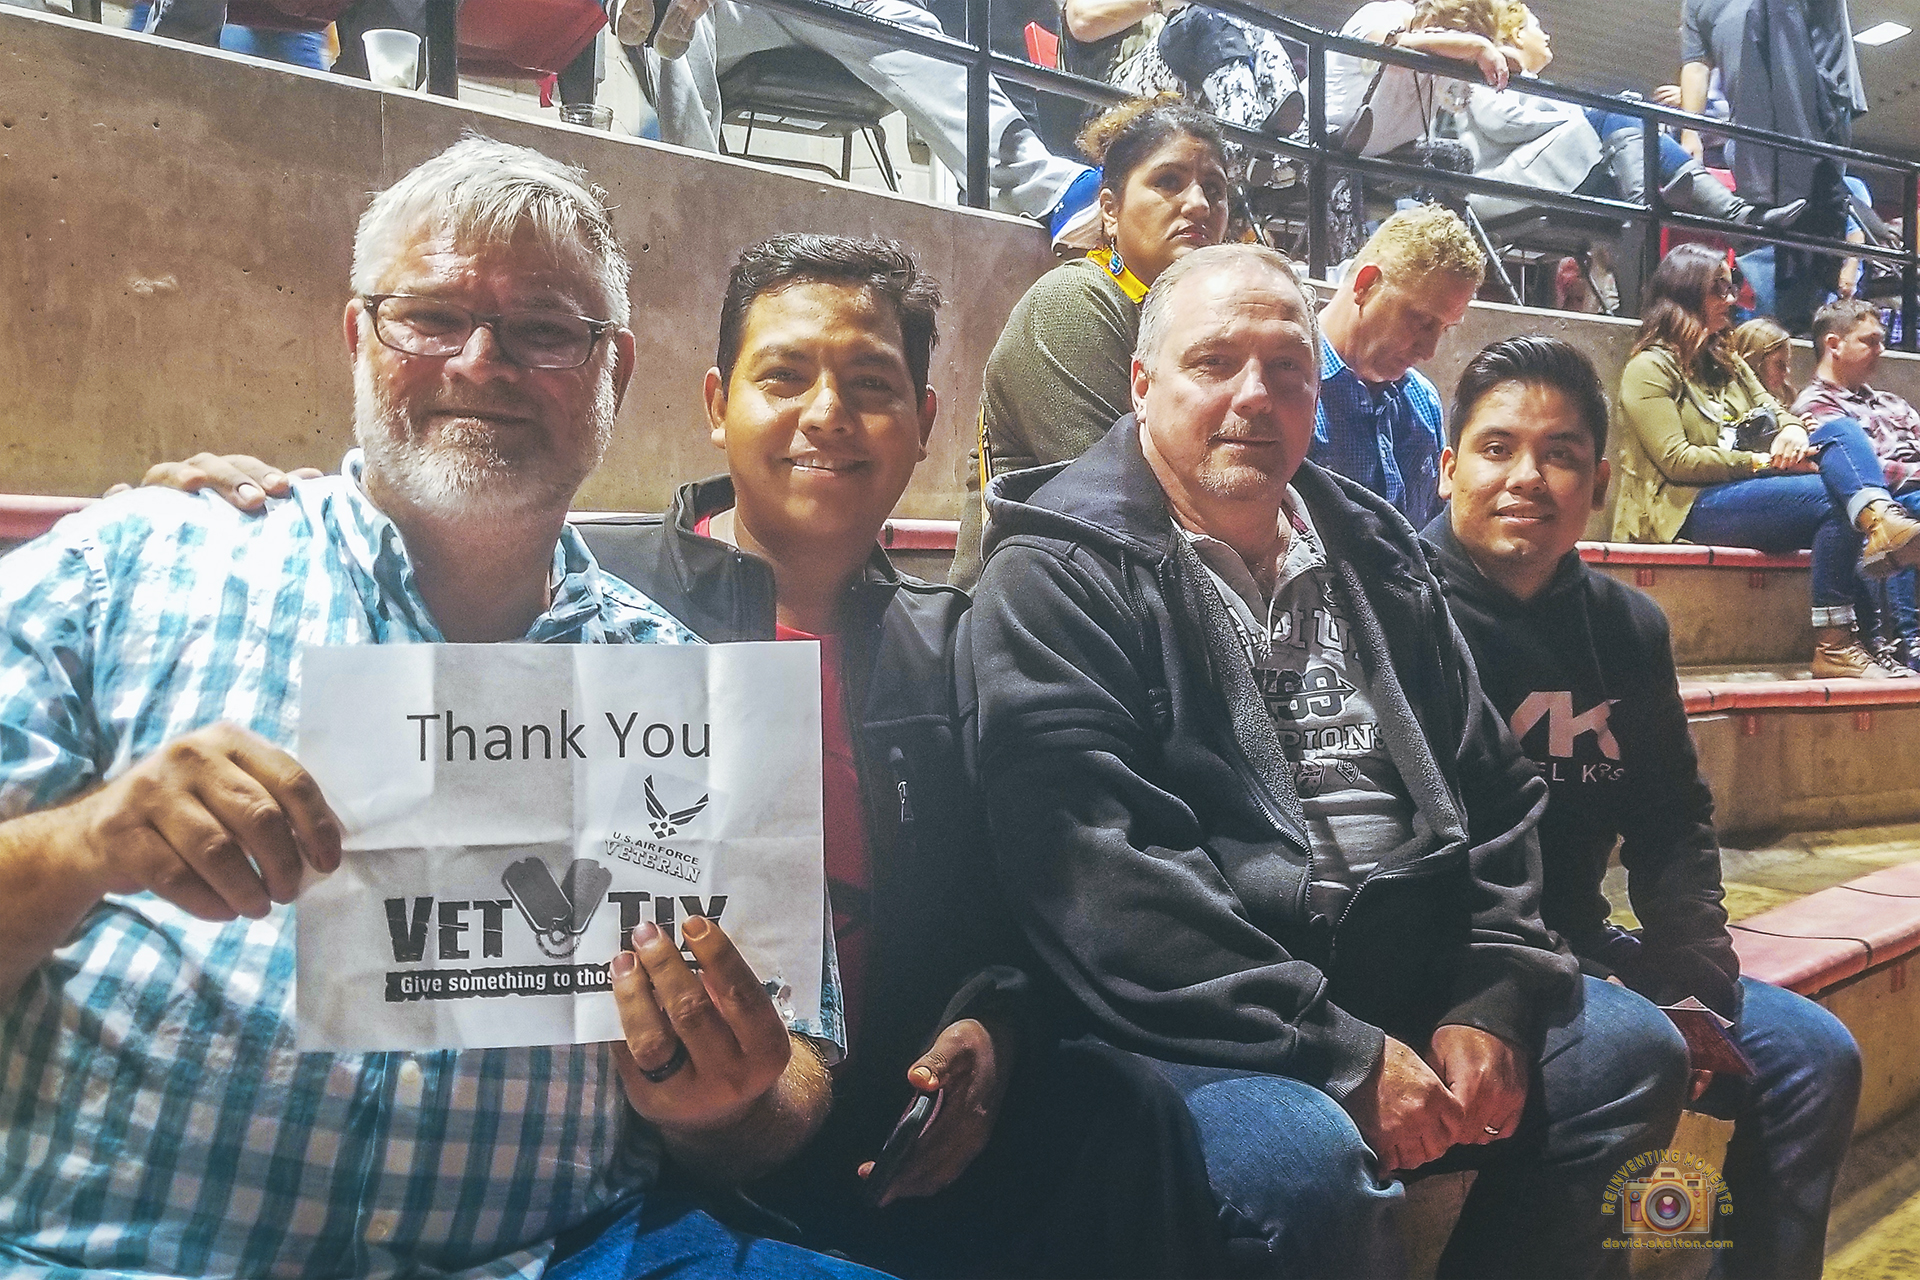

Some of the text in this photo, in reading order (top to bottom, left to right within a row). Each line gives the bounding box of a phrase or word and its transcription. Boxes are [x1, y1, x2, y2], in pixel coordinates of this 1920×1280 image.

[406, 709, 711, 762] Thank You
[604, 839, 701, 884] VETERAN
[613, 831, 700, 866] U.S. AIR FORCE
[384, 896, 513, 963] VET
[400, 976, 443, 994] Give
[448, 971, 547, 992] something
[553, 971, 571, 987] to
